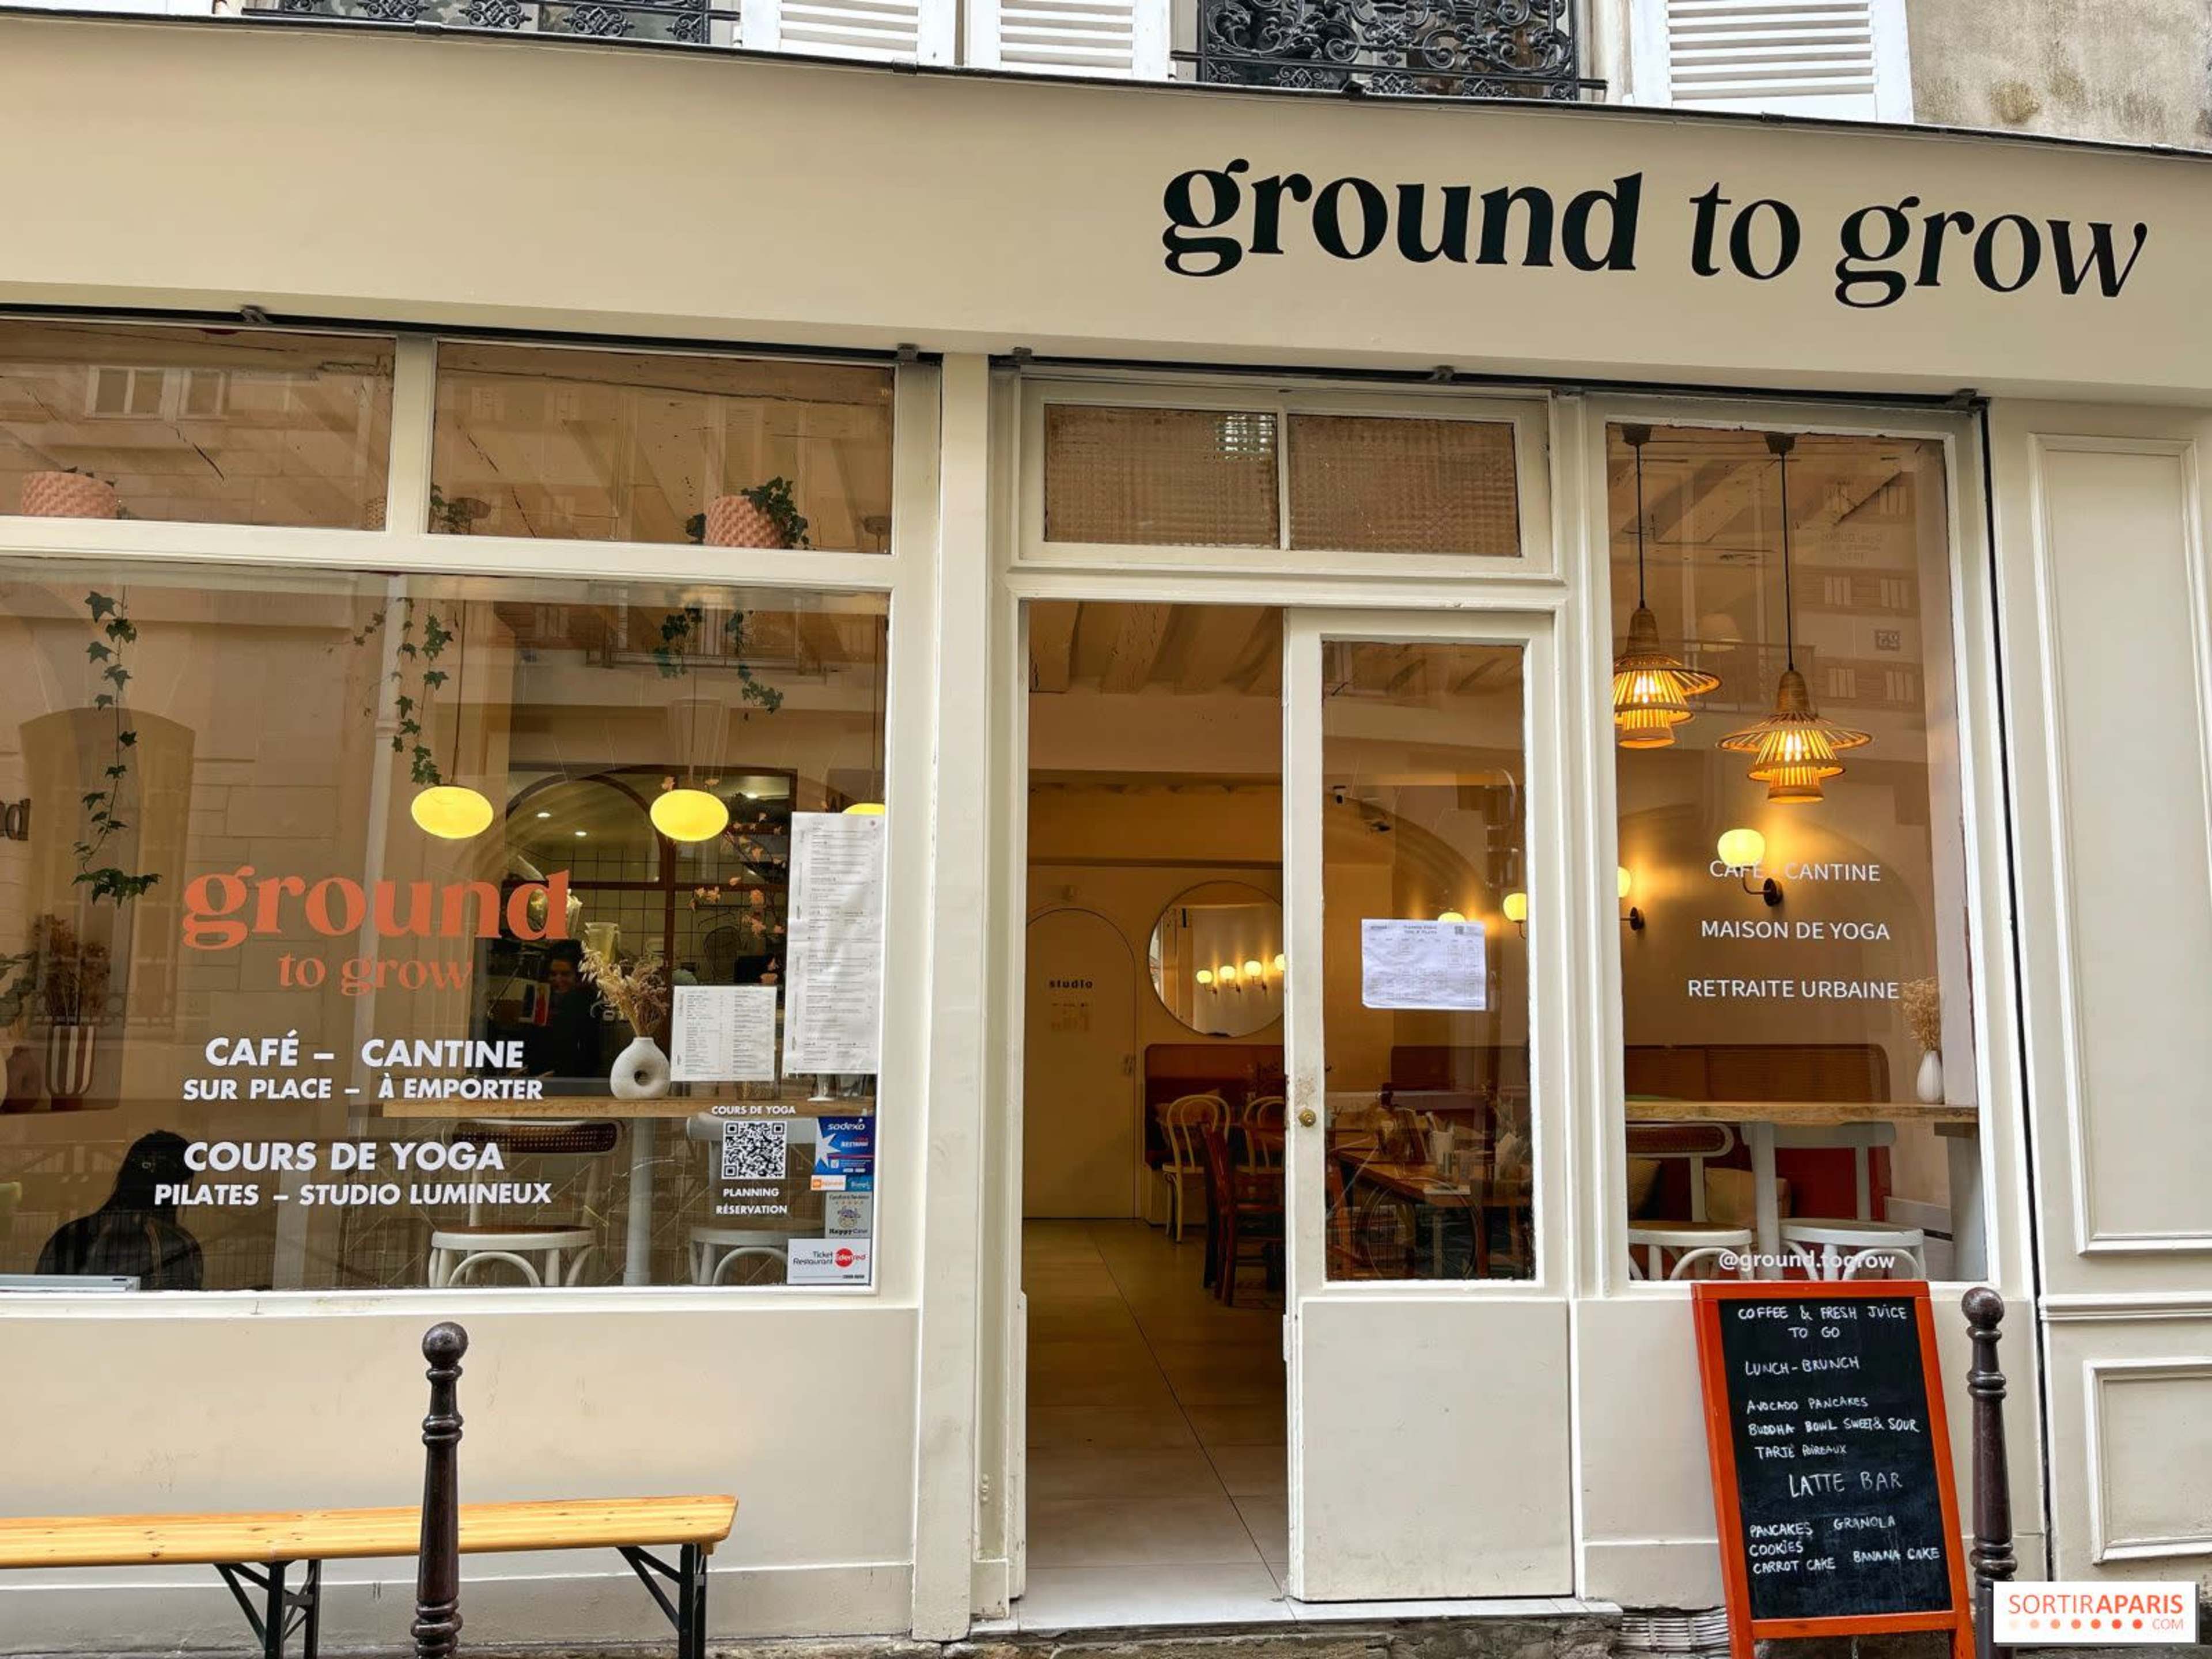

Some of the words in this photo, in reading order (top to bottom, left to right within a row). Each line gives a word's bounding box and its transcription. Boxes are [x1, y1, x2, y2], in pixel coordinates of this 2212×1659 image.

[1162, 158, 1643, 278] ground
[1688, 181, 1802, 280] to
[1834, 196, 2147, 309] grow
[1785, 862, 1881, 881] CANTINE
[182, 865, 570, 950] ground
[1701, 921, 1789, 939] MAISON
[1796, 922, 1824, 940] DE
[1829, 922, 1891, 940] YOGA
[278, 951, 325, 988] to
[340, 955, 472, 997] grow
[1049, 980, 1093, 988] studio
[1688, 979, 1794, 998] RETRAITE
[1801, 981, 1900, 999] URBAINE
[204, 1029, 300, 1067] CAFÉ
[361, 1039, 525, 1068] CANTINE
[183, 1078, 237, 1100] SUR
[249, 1078, 332, 1100] PLACE
[378, 1073, 395, 1099] À
[403, 1078, 543, 1100] EMPORTER
[711, 1106, 747, 1115] COURS
[750, 1106, 762, 1115] DE
[766, 1106, 796, 1115] YOGA
[828, 1119, 866, 1131] sodexo
[183, 1142, 316, 1171] COURS
[331, 1143, 376, 1170] DE
[389, 1142, 504, 1171] YOGA
[154, 1184, 259, 1206] PILATES
[299, 1184, 401, 1206] STUDIO
[410, 1183, 552, 1205] LUMINEUX
[723, 1188, 779, 1197] PLANNING
[716, 1204, 787, 1214] RÉSERVATION
[1719, 1249, 1895, 1272] @ground.togrow
[1737, 1306, 1789, 1320] COFFEE
[1800, 1305, 1813, 1321] &
[1820, 1306, 1857, 1320] FRESH
[1867, 1303, 1907, 1319] JUICE
[1787, 1327, 1808, 1338] TO
[1821, 1327, 1840, 1338] GO
[1747, 1400, 1799, 1414] AVOCADO
[1808, 1396, 1869, 1410] PANCAKES
[1748, 1423, 1795, 1436] BUDDHA
[1805, 1419, 1838, 1433] BOWL
[1888, 1418, 1921, 1433] SOUR
[1789, 1472, 1845, 1498] LATTE
[1860, 1471, 1903, 1491] BAR
[1749, 1522, 1813, 1537] PANCAKES
[1833, 1515, 1896, 1531] GRANOLA
[1749, 1540, 1804, 1556] COOKIES
[1853, 1550, 1900, 1563] BANANA
[1907, 1548, 1941, 1560] CAKE
[1752, 1560, 1800, 1574] CARROT
[1806, 1558, 1836, 1573] CAKE
